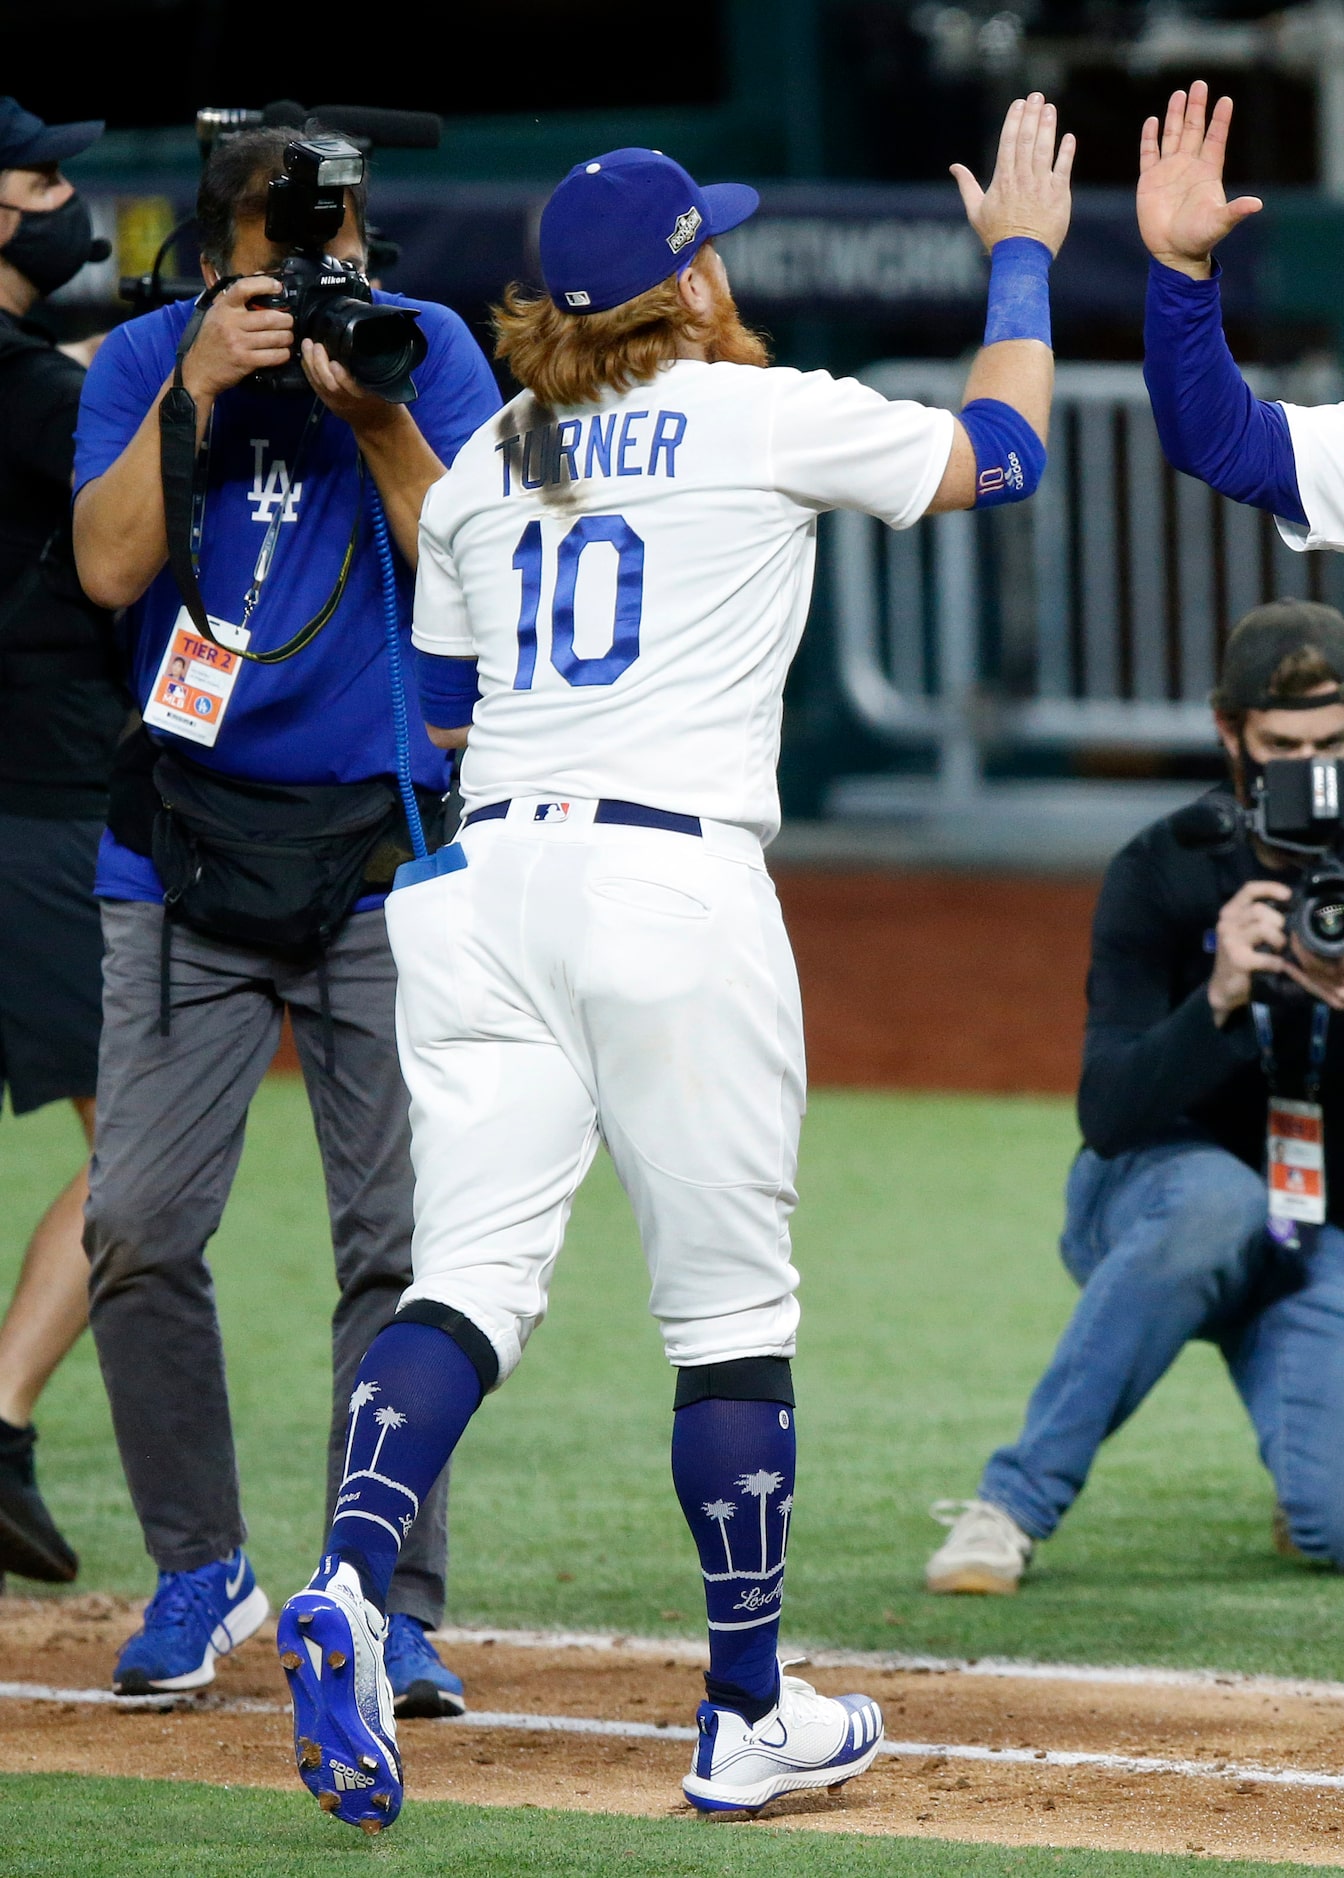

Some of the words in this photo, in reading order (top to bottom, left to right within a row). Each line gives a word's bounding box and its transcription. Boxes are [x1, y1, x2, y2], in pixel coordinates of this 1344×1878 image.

[320, 276, 346, 285] Nikon
[494, 410, 688, 497] TURNER
[1008, 452, 1024, 490] adidas
[247, 439, 302, 522] LA
[979, 467, 1004, 494] 10
[512, 514, 645, 690] 10
[183, 637, 218, 663] TIER
[220, 653, 232, 669] 2
[329, 1759, 375, 1786] adidas
